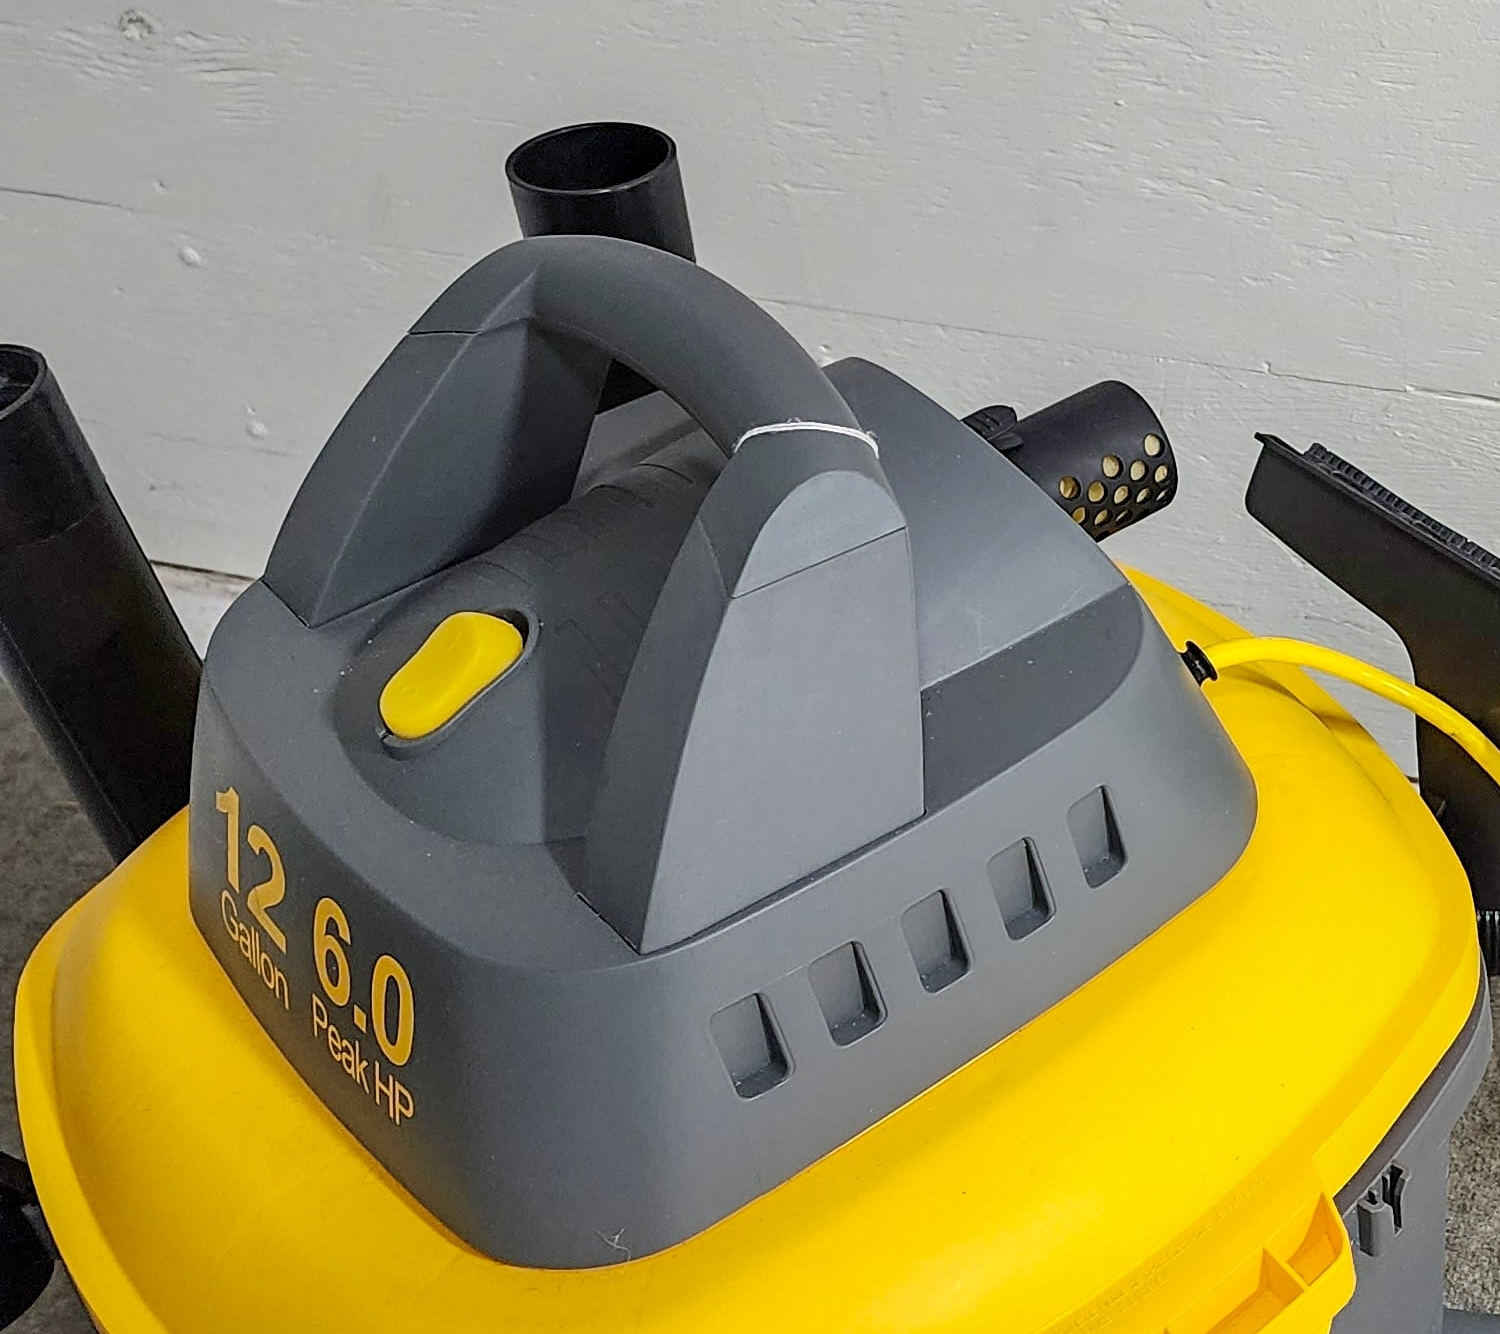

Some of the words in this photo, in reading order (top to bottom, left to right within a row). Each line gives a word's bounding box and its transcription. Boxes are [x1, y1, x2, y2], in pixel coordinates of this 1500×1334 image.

[215, 786, 287, 955] 12
[313, 897, 415, 1067] 6.0
[220, 889, 290, 1010] Gallon
[311, 994, 370, 1095] Peak
[374, 1061, 415, 1126] HP
